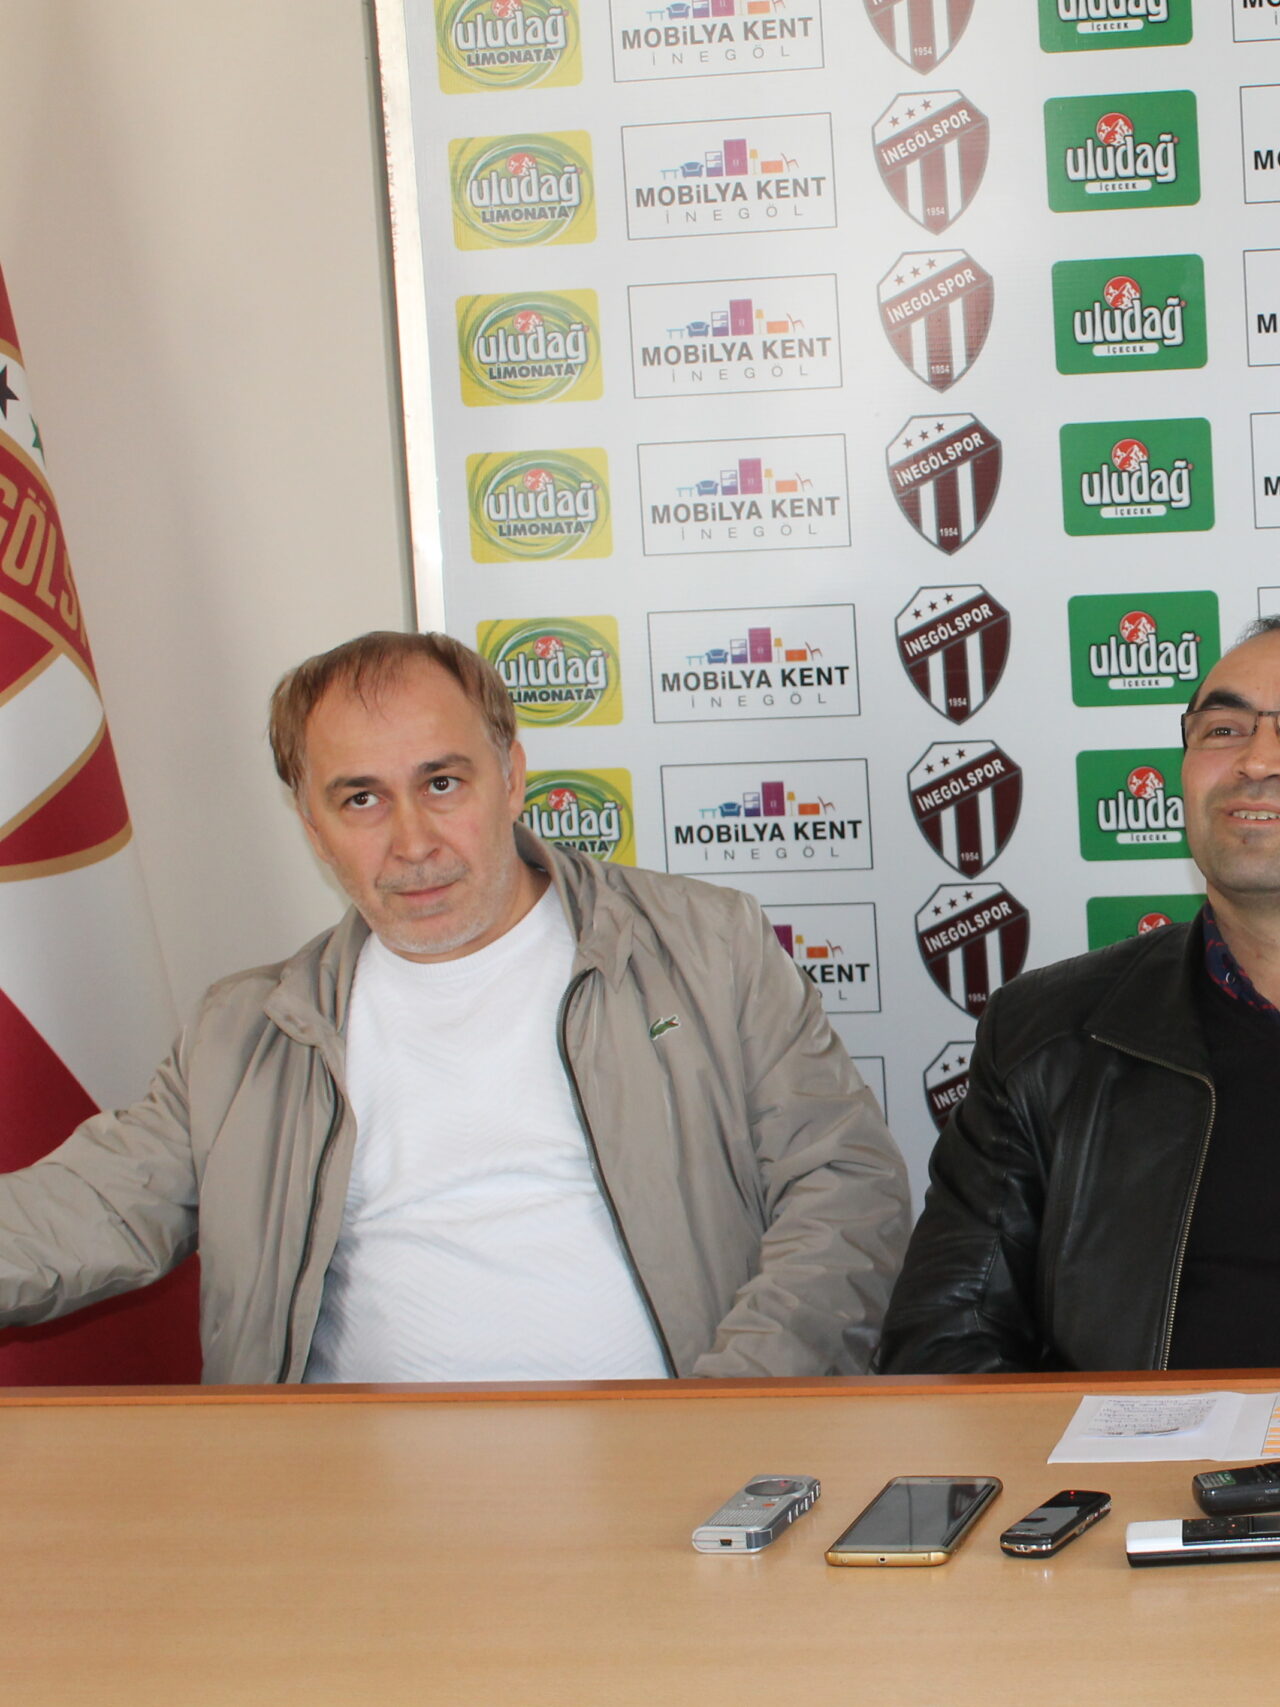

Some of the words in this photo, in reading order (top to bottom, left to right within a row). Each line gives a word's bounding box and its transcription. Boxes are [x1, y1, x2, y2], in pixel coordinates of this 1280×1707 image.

[455, 10, 567, 50] uludağ
[743, 18, 813, 41] KENT
[913, 46, 932, 57] 1954
[881, 108, 972, 166] İNEGÖLSPOR
[1066, 133, 1177, 183] uludağ
[471, 166, 581, 207] uludağ
[756, 177, 826, 200] KENT
[926, 207, 945, 216] 1954
[887, 268, 976, 325] İNEGÖLSPOR
[1073, 296, 1184, 346] uludağ
[477, 323, 589, 364] uludağ
[762, 337, 831, 361] KENT
[931, 364, 949, 374] 1954
[895, 431, 985, 487] İNEGÖLSPOR
[486, 482, 597, 522] uludağ
[1081, 460, 1191, 508] uludağ
[772, 497, 840, 518] KENT
[939, 528, 958, 537] 1954
[904, 602, 993, 658] İNEGÖLSPOR
[1089, 632, 1199, 680] uludağ
[781, 667, 849, 687] KENT
[948, 698, 967, 707] 1954
[916, 759, 1005, 812] İNEGÖLSPOR
[1097, 788, 1186, 831] uluda
[794, 820, 862, 840] KENT
[960, 852, 979, 861] 1954
[924, 901, 1013, 953] İNEGÖLSPOR
[802, 963, 870, 983] KENT
[968, 993, 988, 1002] 1954
